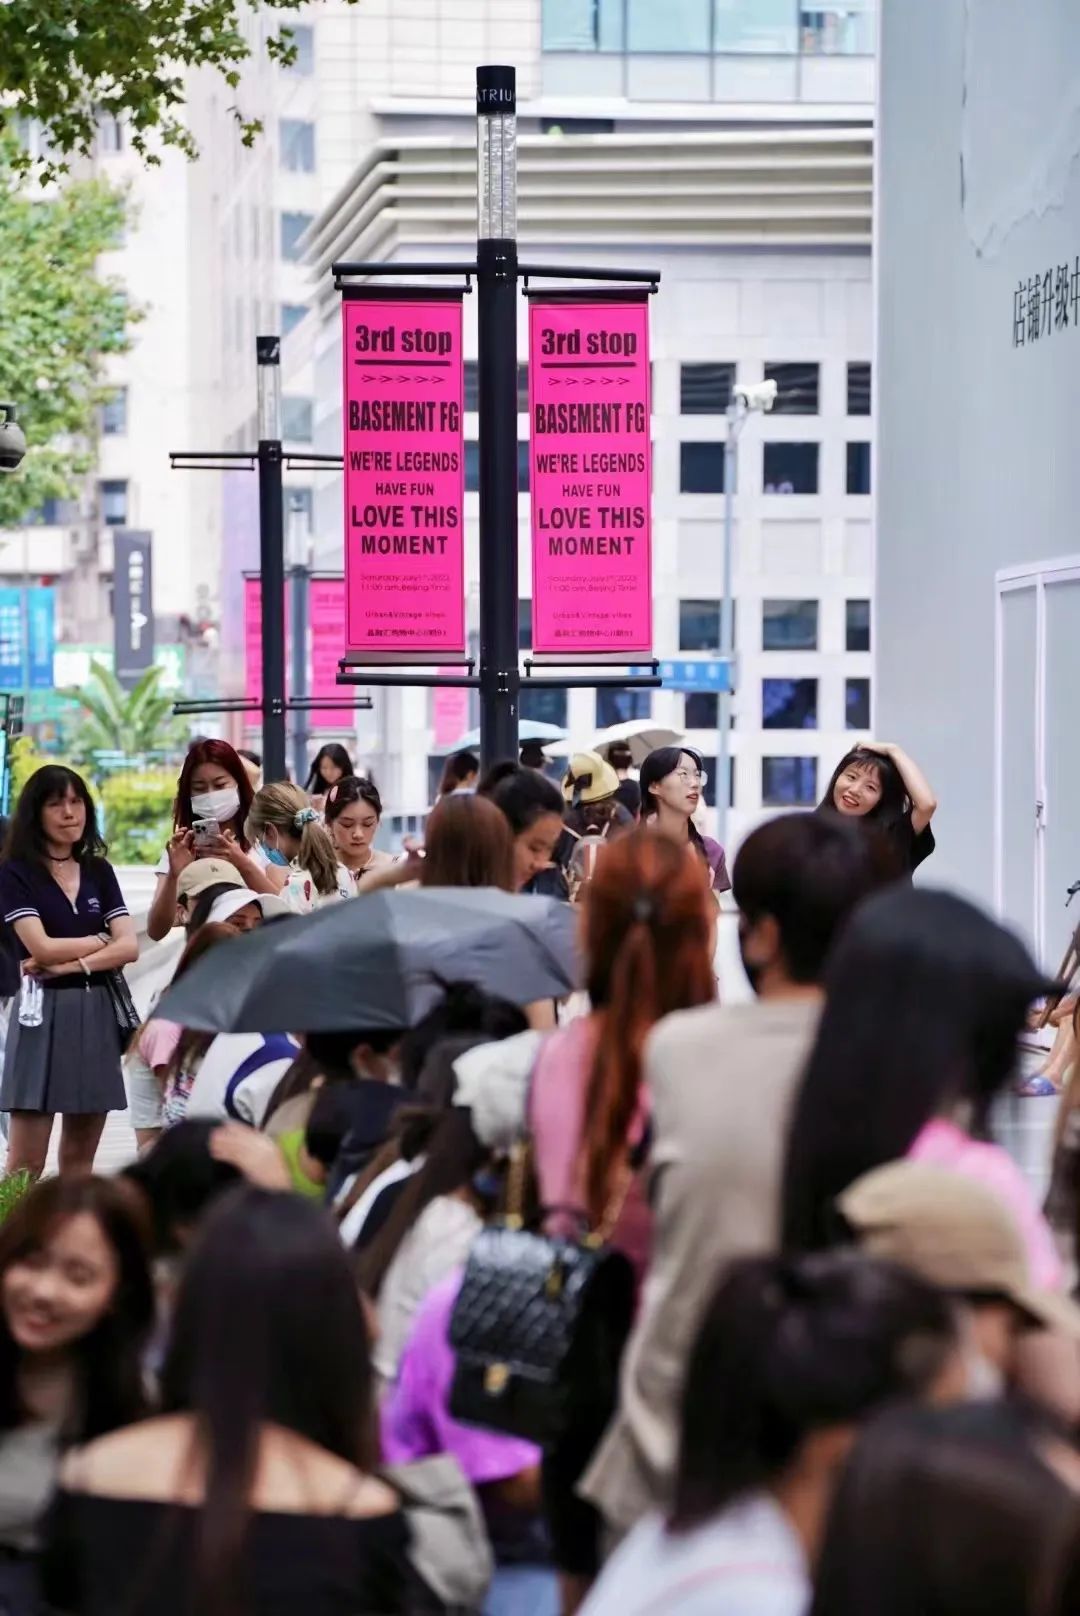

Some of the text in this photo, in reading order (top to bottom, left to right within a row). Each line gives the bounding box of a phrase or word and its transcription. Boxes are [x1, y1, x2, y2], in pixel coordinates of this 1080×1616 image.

[356, 325, 452, 356] 3rd stop
[541, 328, 637, 356] 3rd stop
[349, 400, 459, 432] BASEMENT FG
[536, 402, 645, 434] BASEMENT FG
[350, 451, 459, 472] WE'RE LEGENDS
[536, 453, 645, 473] WE'RE LEGENDS
[375, 482, 434, 496] HAVE FUN
[562, 484, 621, 497] HAVE FUN
[351, 505, 458, 528] LOVE THIS
[539, 507, 645, 529] LOVE THIS
[361, 535, 448, 555] MOMENT
[548, 537, 635, 556] MOMENT
